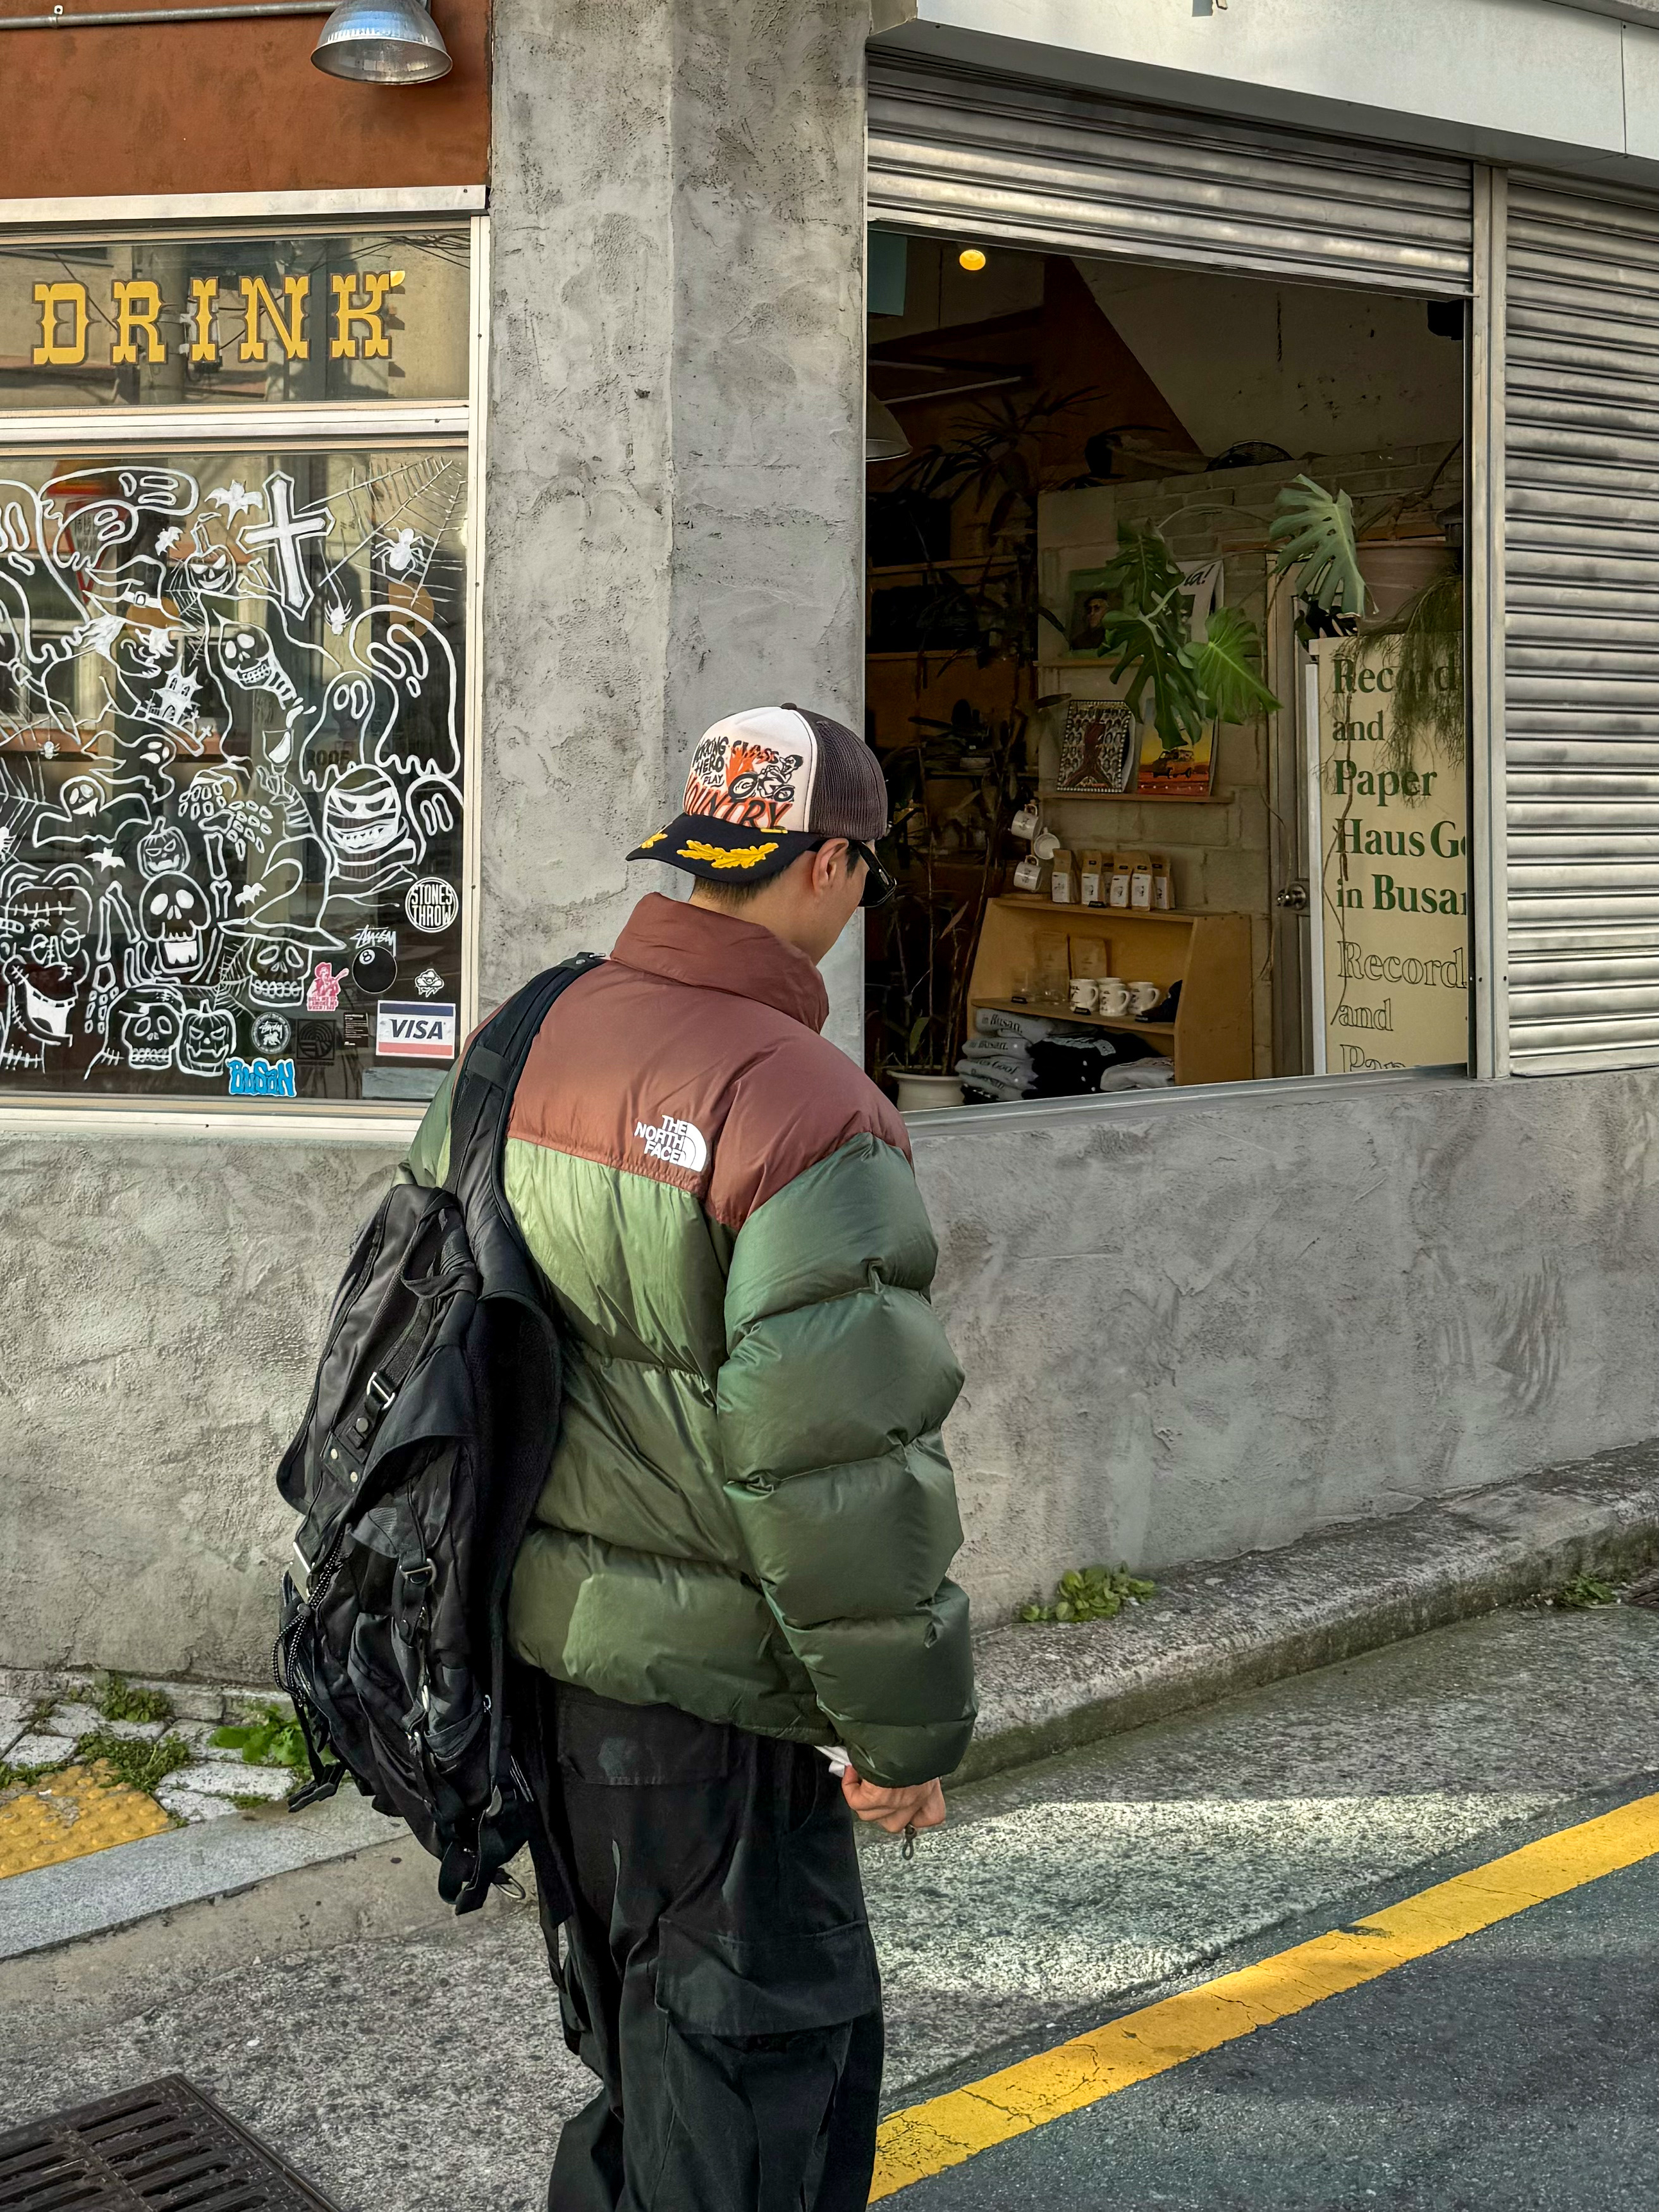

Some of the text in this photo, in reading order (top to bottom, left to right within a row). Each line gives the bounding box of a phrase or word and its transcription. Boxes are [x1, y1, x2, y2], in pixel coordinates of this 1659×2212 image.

[31, 270, 392, 366] DRINK
[1333, 710, 1385, 740] and
[694, 755, 725, 776] HERO
[703, 774, 723, 785] PLAY
[1333, 760, 1437, 806] Paper
[1335, 819, 1425, 857] Haus
[411, 884, 453, 905] STONES
[1337, 878, 1364, 908] in
[412, 905, 451, 926] THROW
[362, 951, 372, 962] 8
[1337, 941, 1467, 989] Record
[1339, 998, 1393, 1031] and
[389, 1019, 443, 1040] VISA
[634, 1121, 685, 1151] NORTH
[662, 1115, 688, 1135] THE
[644, 1140, 681, 1164] FACE
